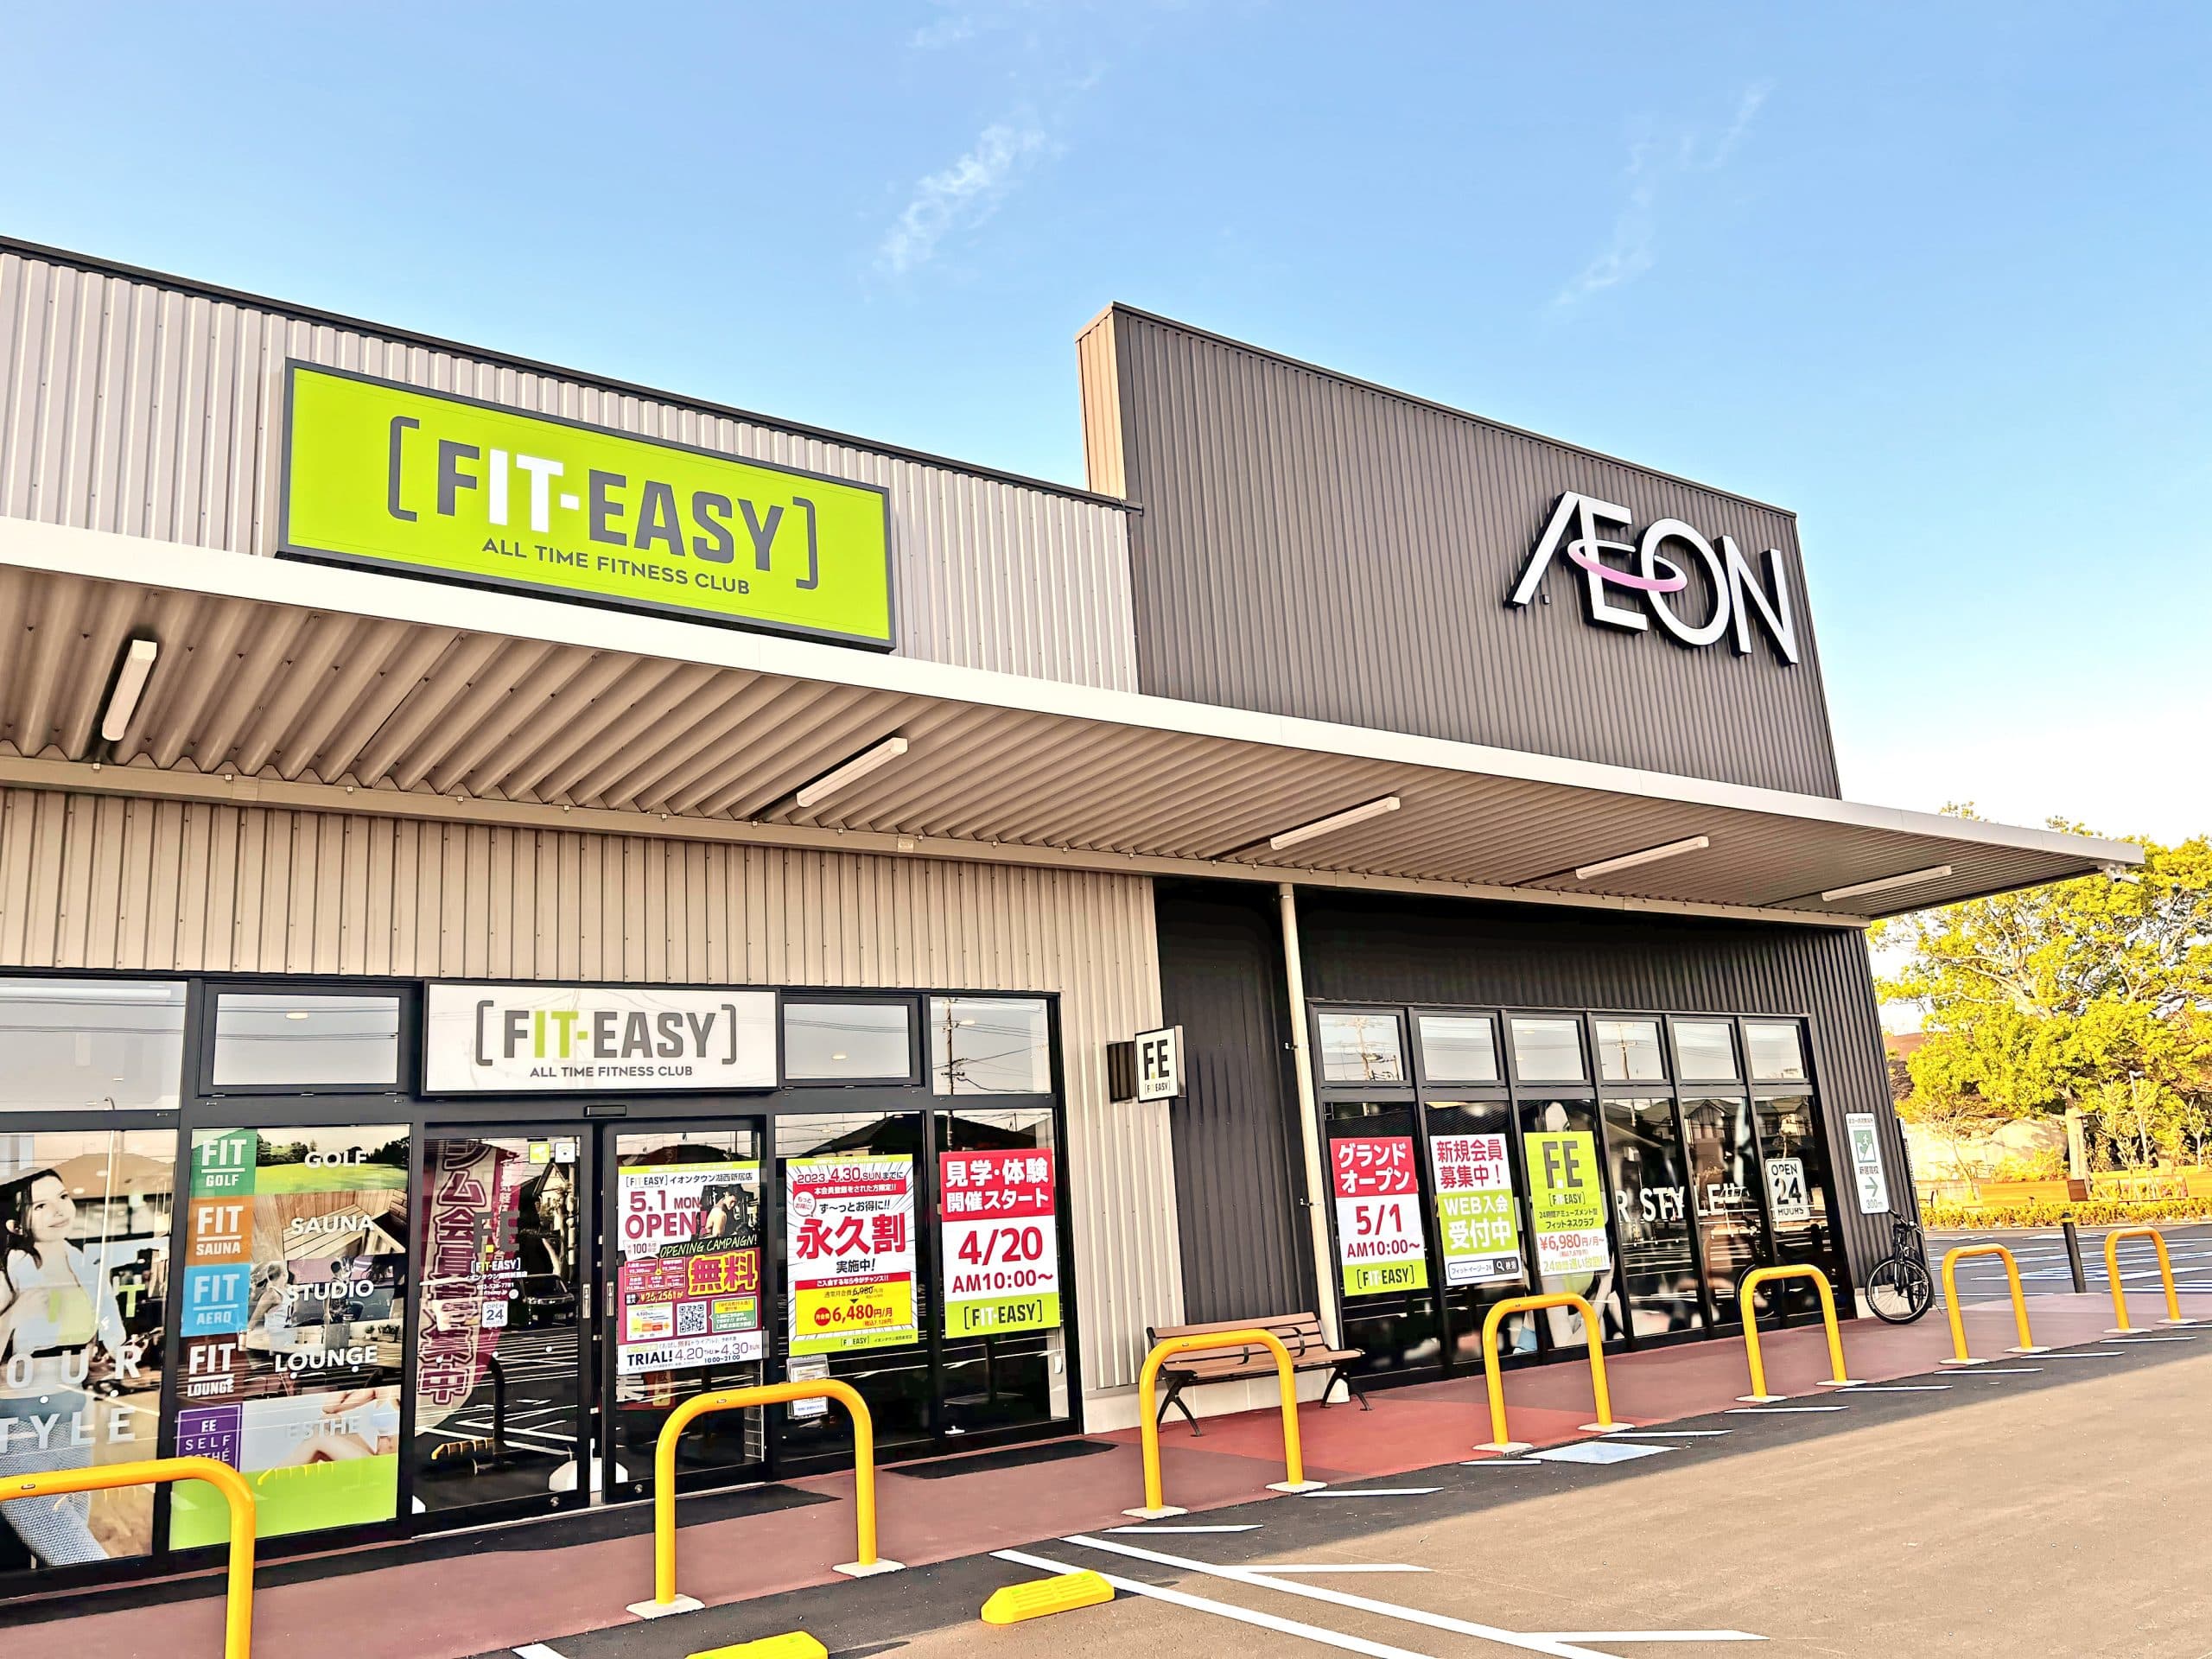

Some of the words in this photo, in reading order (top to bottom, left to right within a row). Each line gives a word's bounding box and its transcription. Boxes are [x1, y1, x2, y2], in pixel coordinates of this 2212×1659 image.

[481, 537, 527, 559] ALL
[535, 545, 589, 569] TIME
[596, 556, 689, 586] FITNESS
[695, 573, 751, 596] CLUB
[530, 1066, 556, 1077] ALL
[563, 1066, 594, 1077] TIME
[599, 1066, 654, 1077] FITNESS
[658, 1066, 693, 1077] CLUB
[201, 1139, 247, 1166] FIT
[304, 1149, 366, 1170] GOLF
[1338, 1141, 1407, 1168] グランド
[1437, 1139, 1503, 1163] 新規会員
[206, 1174, 239, 1188] GOLF
[945, 1157, 1049, 1188] 見学・体験
[1340, 1167, 1410, 1193] オープン
[1771, 1164, 1797, 1175] OPEN
[630, 1190, 666, 1212] 5.1
[947, 1188, 1049, 1213] 開催スタート
[1775, 1177, 1802, 1205] 24
[1444, 1196, 1509, 1217] WEB入会
[1778, 1206, 1803, 1216] HOURS
[197, 1205, 244, 1234] FIT
[291, 1214, 375, 1236] SAUNA
[625, 1211, 708, 1239] OPEN!
[1356, 1204, 1402, 1236] 5/1
[1546, 1217, 1594, 1229] フィットネスクラブ
[797, 1212, 906, 1260] 永久割
[1448, 1217, 1511, 1250] 受付中
[196, 1241, 241, 1256] SAUNA
[660, 1242, 703, 1257] OPENING
[707, 1236, 758, 1254] CAMPAIGN!
[958, 1226, 1043, 1266] 4/20
[688, 1251, 758, 1295] 無料
[194, 1273, 240, 1303] FIT
[285, 1279, 374, 1303] STUDIO
[196, 1310, 232, 1325] AERO
[486, 1309, 504, 1321] 24
[188, 1343, 236, 1375] FIT
[275, 1345, 378, 1373] LOUNGE
[627, 1351, 673, 1366] TRIAL!
[674, 1347, 703, 1360] 4.20
[721, 1343, 748, 1355] 4.30
[188, 1381, 234, 1397] LOUNGE
[185, 1434, 231, 1451] SELF
